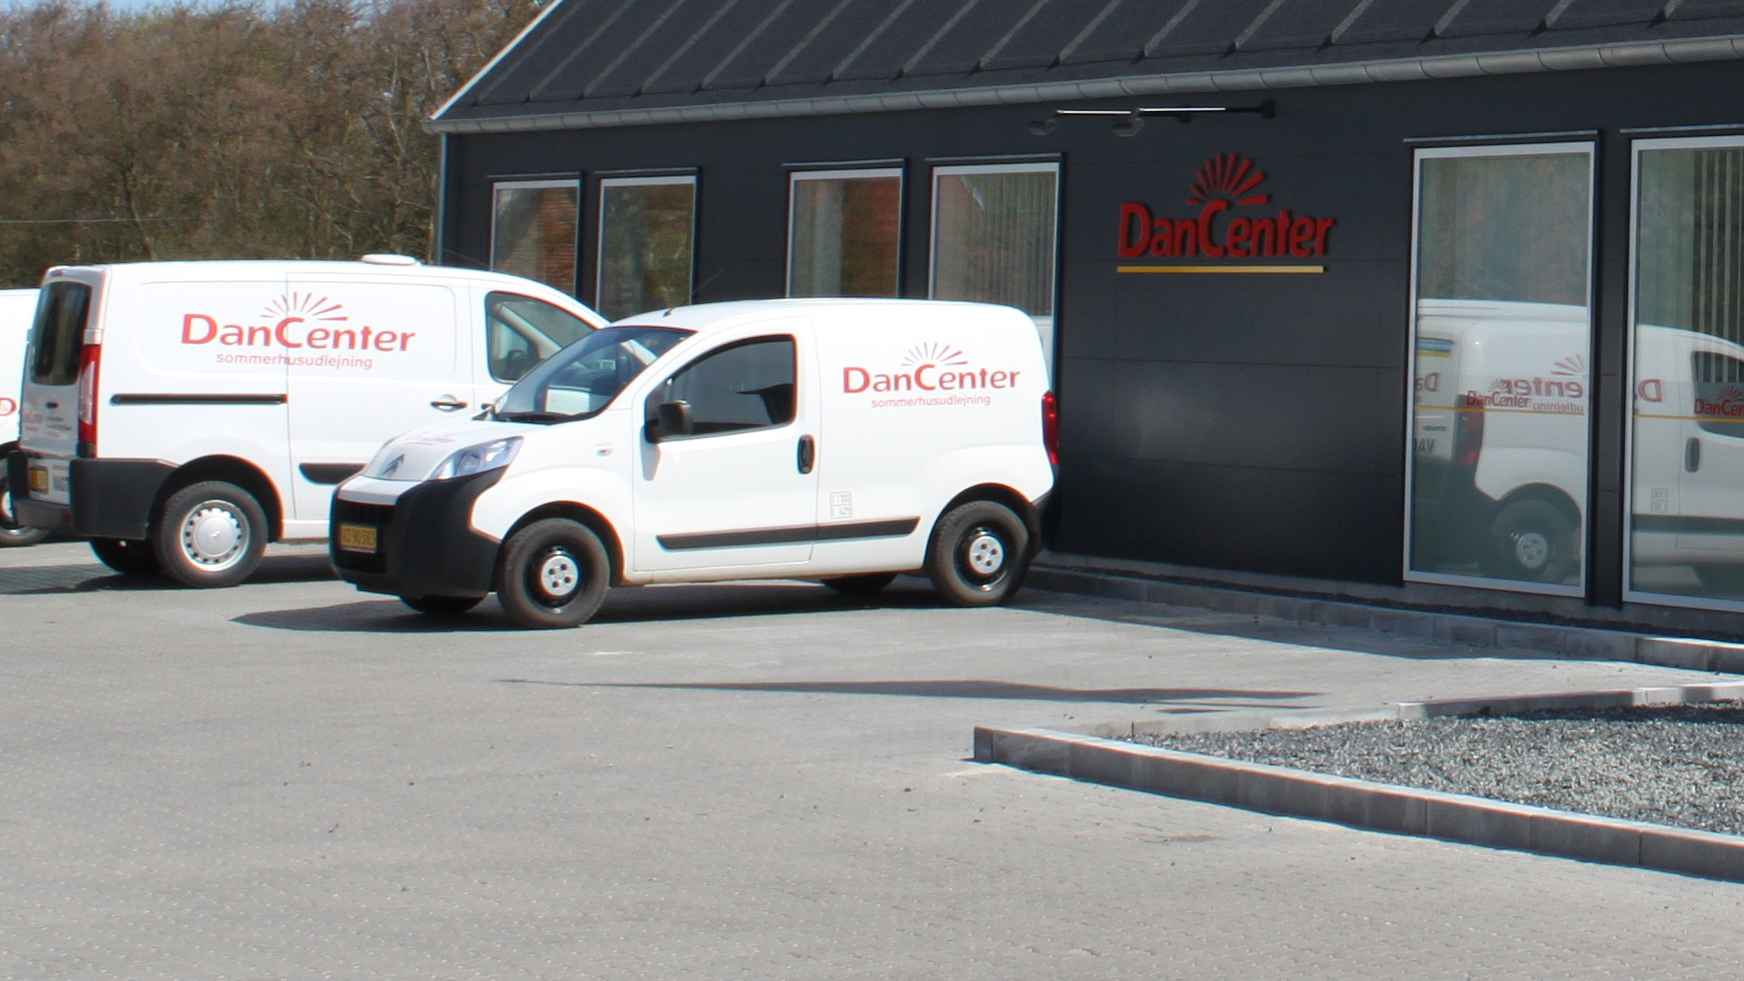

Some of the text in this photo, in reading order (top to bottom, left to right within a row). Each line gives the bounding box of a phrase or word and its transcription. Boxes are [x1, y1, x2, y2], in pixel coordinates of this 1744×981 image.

[1117, 199, 1337, 258] DanCenter
[181, 313, 416, 352] DanCenter
[216, 353, 373, 371] sommerhusudlejning
[843, 364, 1021, 394] DanCenter
[871, 393, 991, 409] sommerhusudlejning
[1466, 390, 1530, 408] DanCenter
